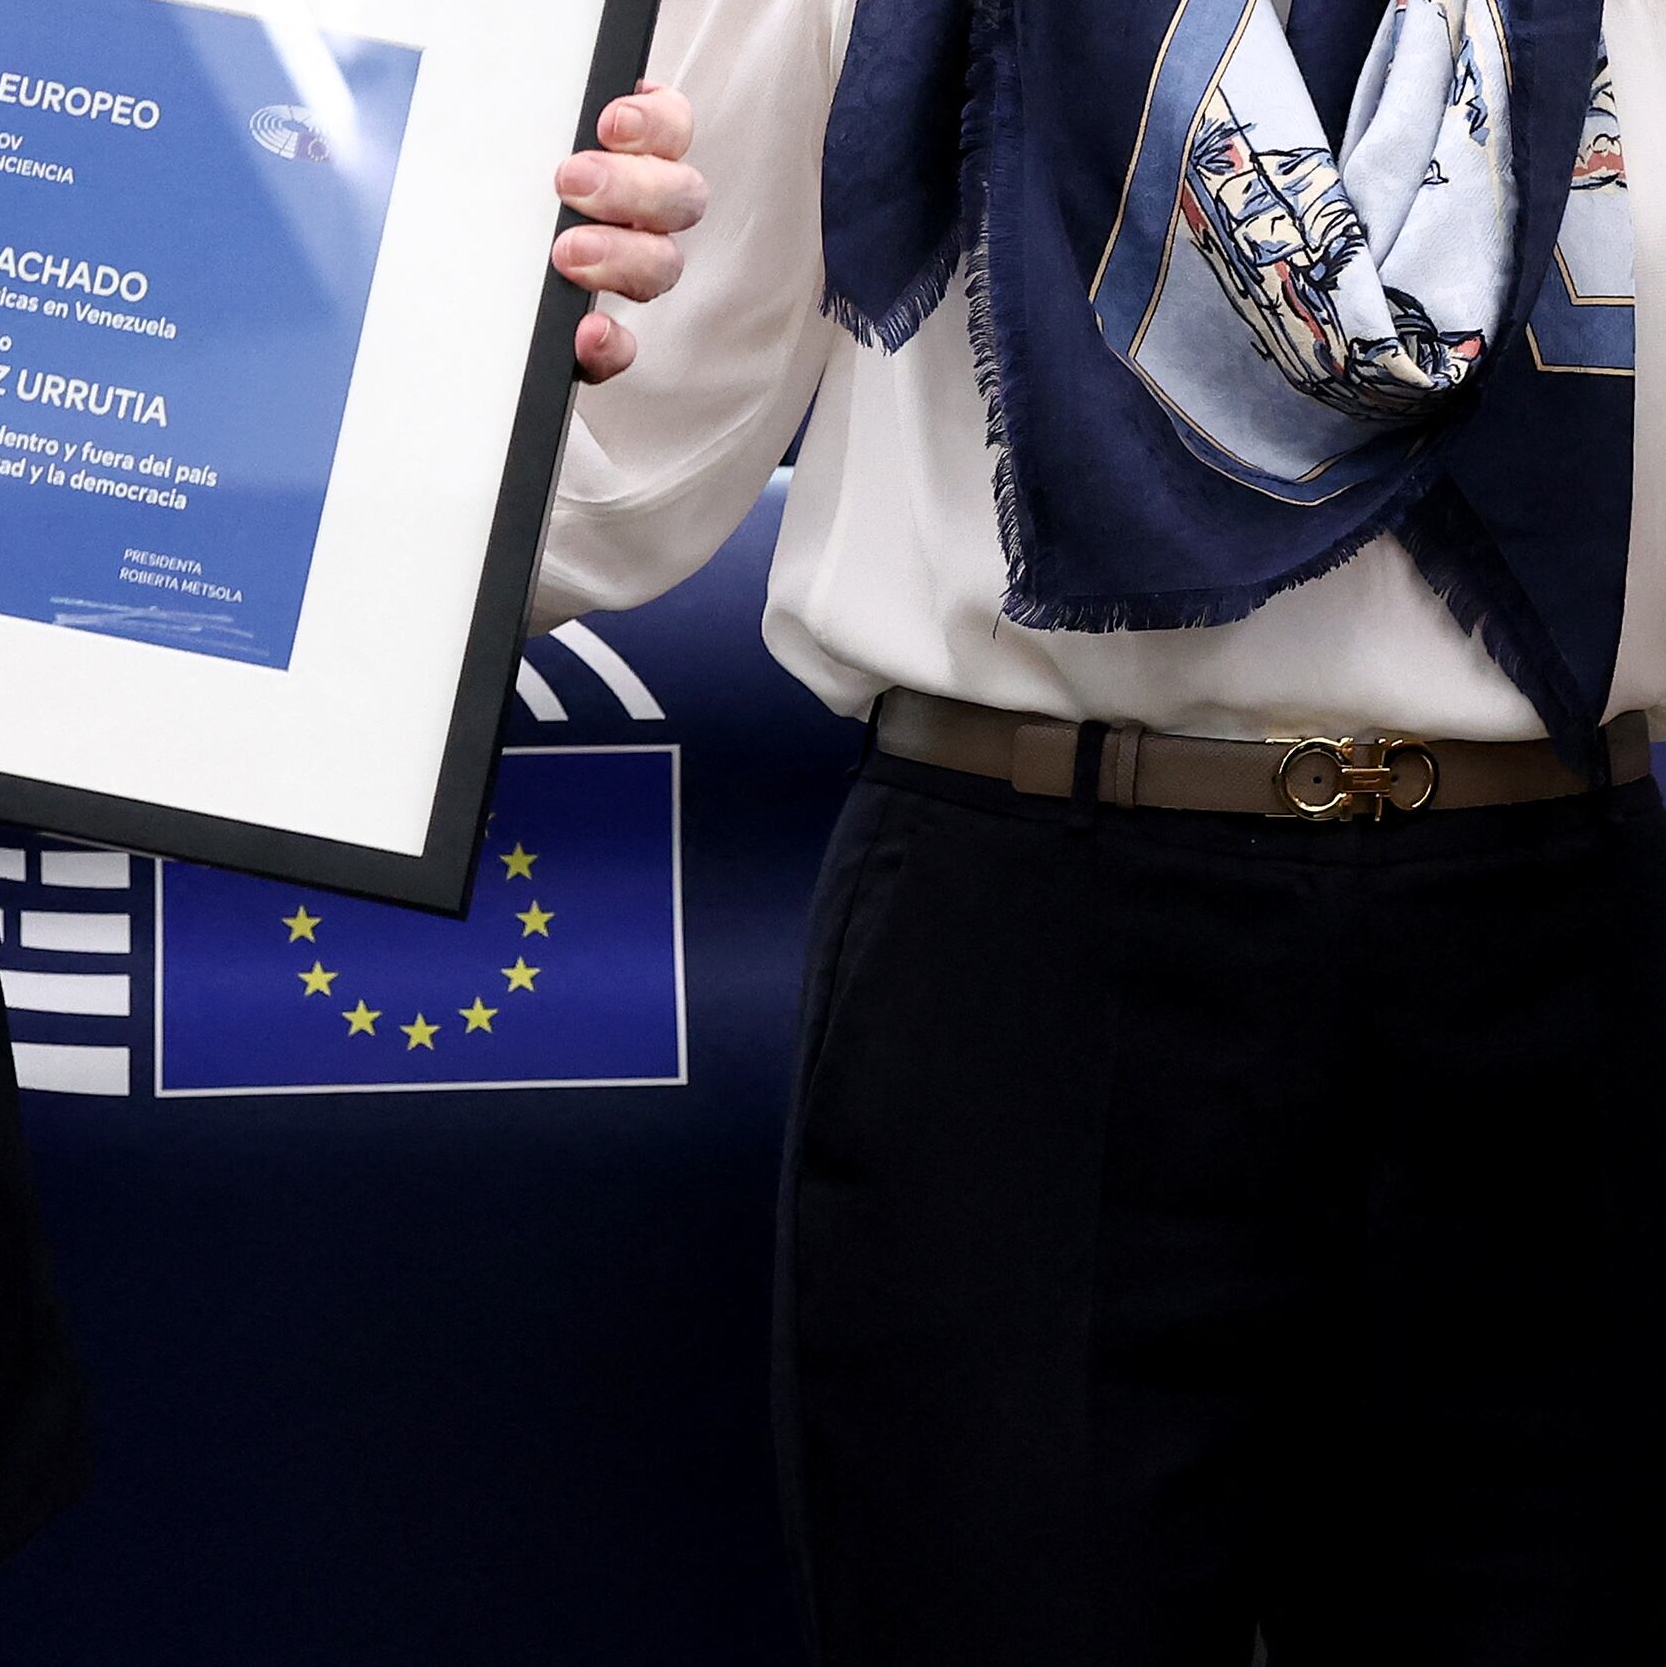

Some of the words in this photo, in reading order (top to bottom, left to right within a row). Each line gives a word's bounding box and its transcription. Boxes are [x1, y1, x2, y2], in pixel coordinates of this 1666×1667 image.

[42, 299, 69, 319] en
[74, 300, 177, 339] Venezuela
[15, 367, 167, 427] URRUTIA
[62, 442, 78, 462] y
[80, 440, 135, 470] fuera
[137, 453, 172, 478] del
[173, 464, 218, 487] país
[28, 464, 44, 485] y
[45, 462, 66, 486] la
[68, 468, 187, 510] democracia
[122, 547, 202, 576] PRESIDENTA
[118, 566, 179, 590] ROBERTA
[179, 578, 242, 603] METSOLA
